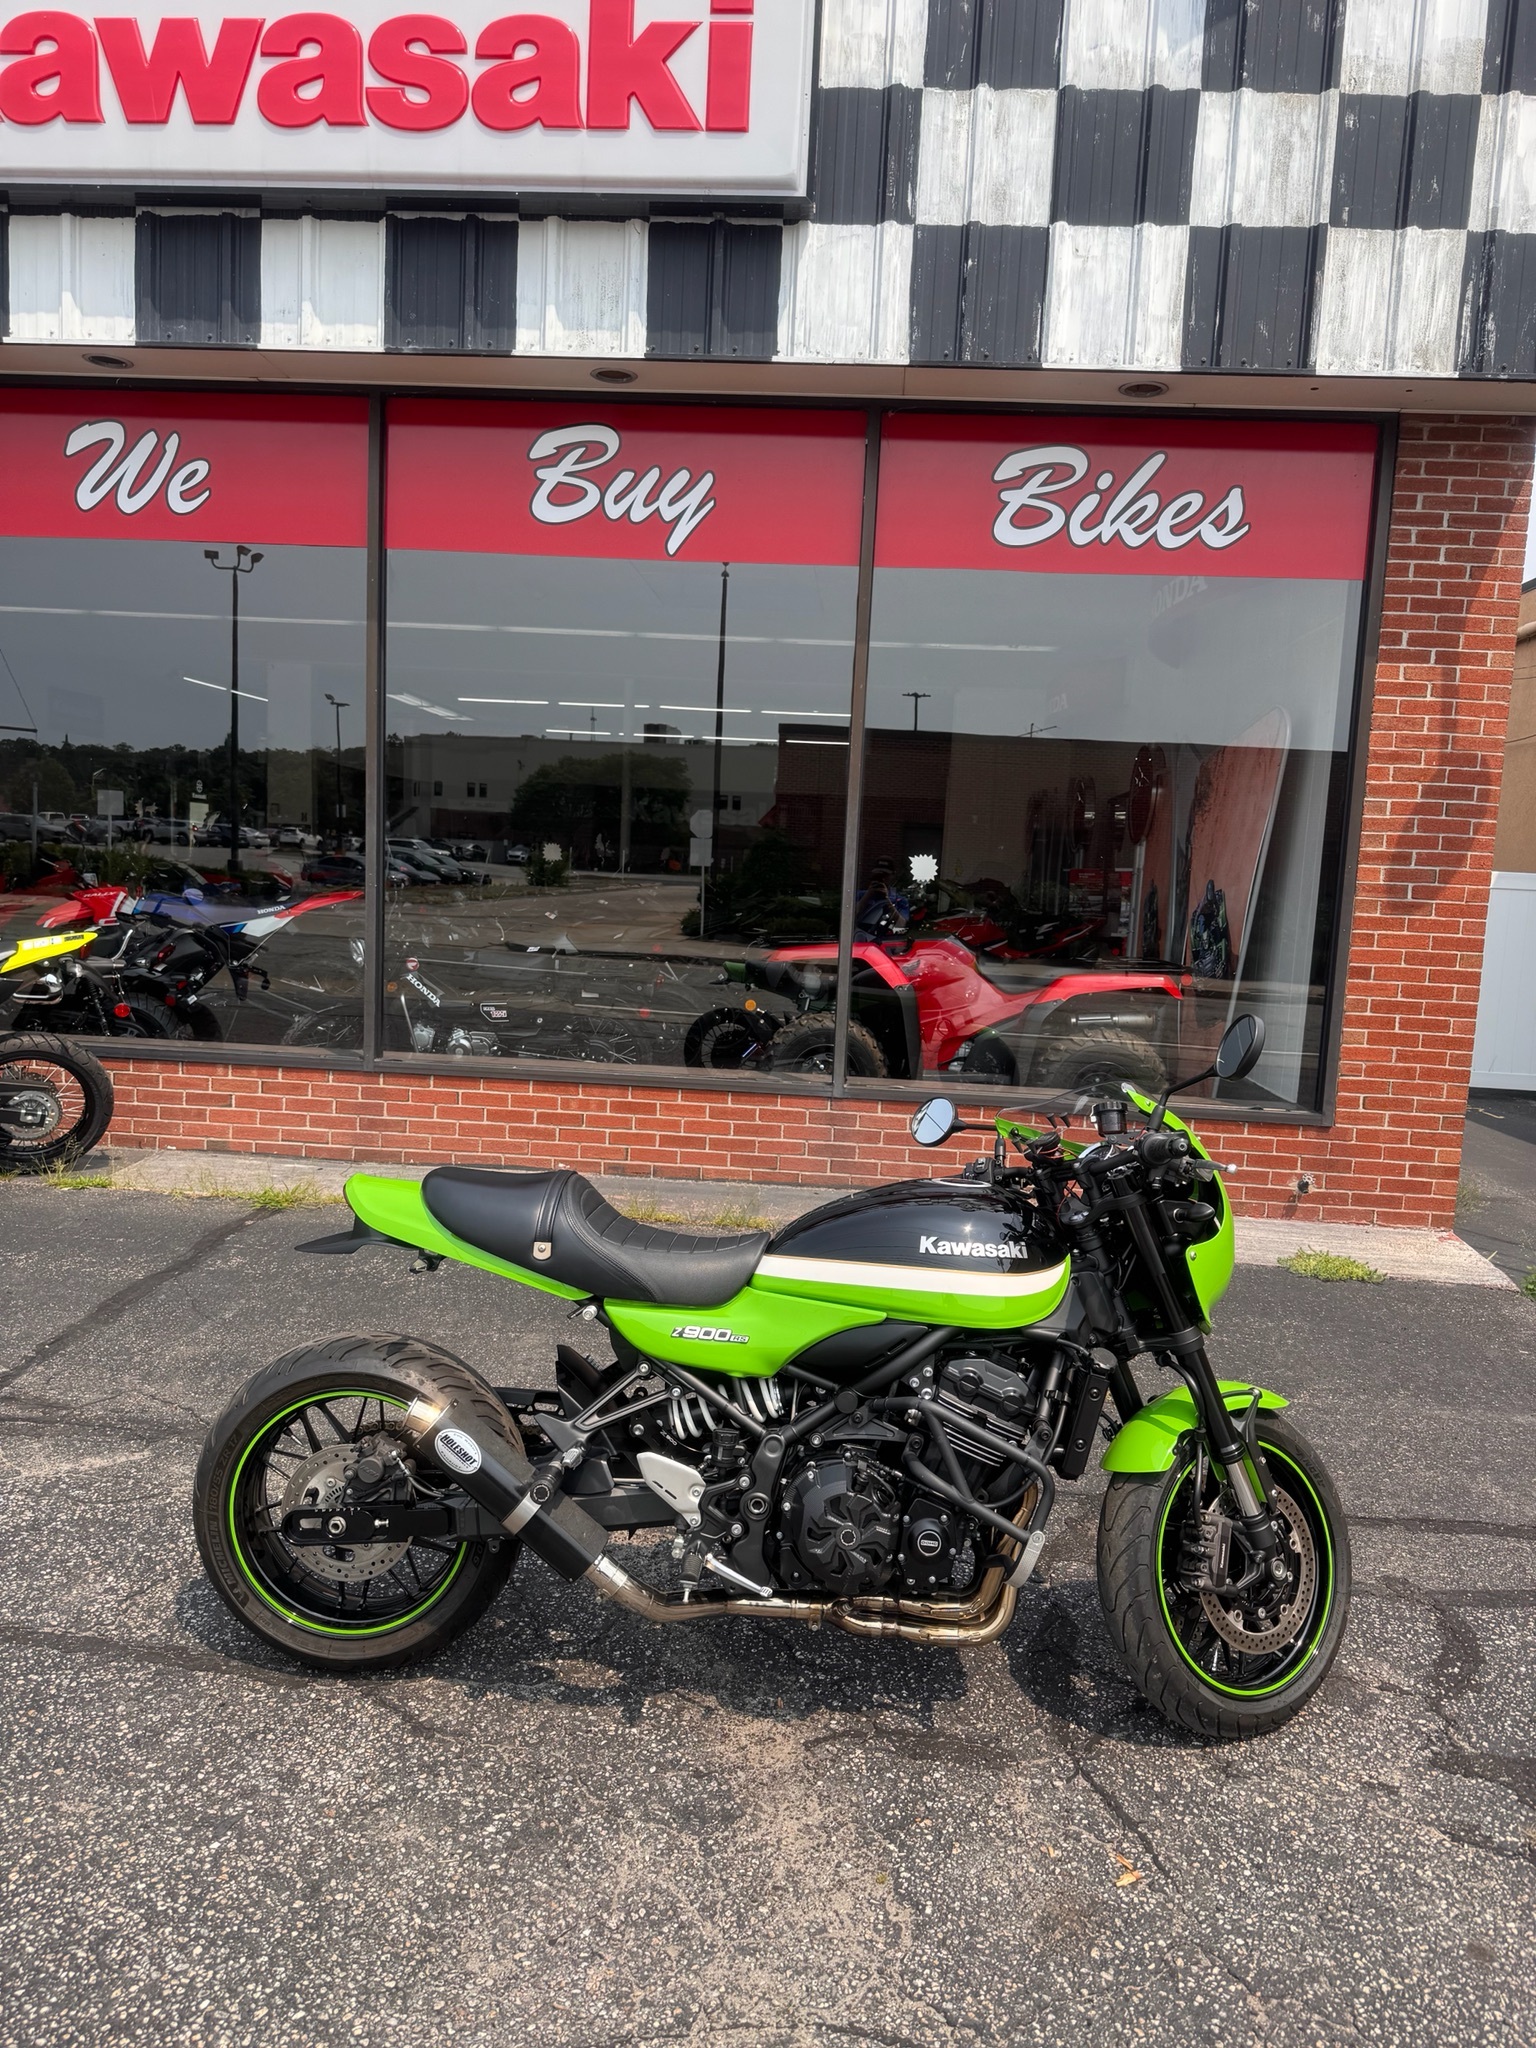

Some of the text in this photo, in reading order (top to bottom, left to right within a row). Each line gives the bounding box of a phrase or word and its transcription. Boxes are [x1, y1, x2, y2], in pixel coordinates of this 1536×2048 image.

[0, 0, 755, 133] awasaki
[64, 419, 1251, 557] We Buy Bikes
[1152, 576, 1208, 618] ONDA
[257, 904, 286, 915] HONDA
[406, 973, 441, 1008] HONDA
[919, 1236, 1028, 1259] Kawasaki
[440, 1434, 477, 1465] HOLESHOT
[208, 1519, 237, 1585] MICHELIN
